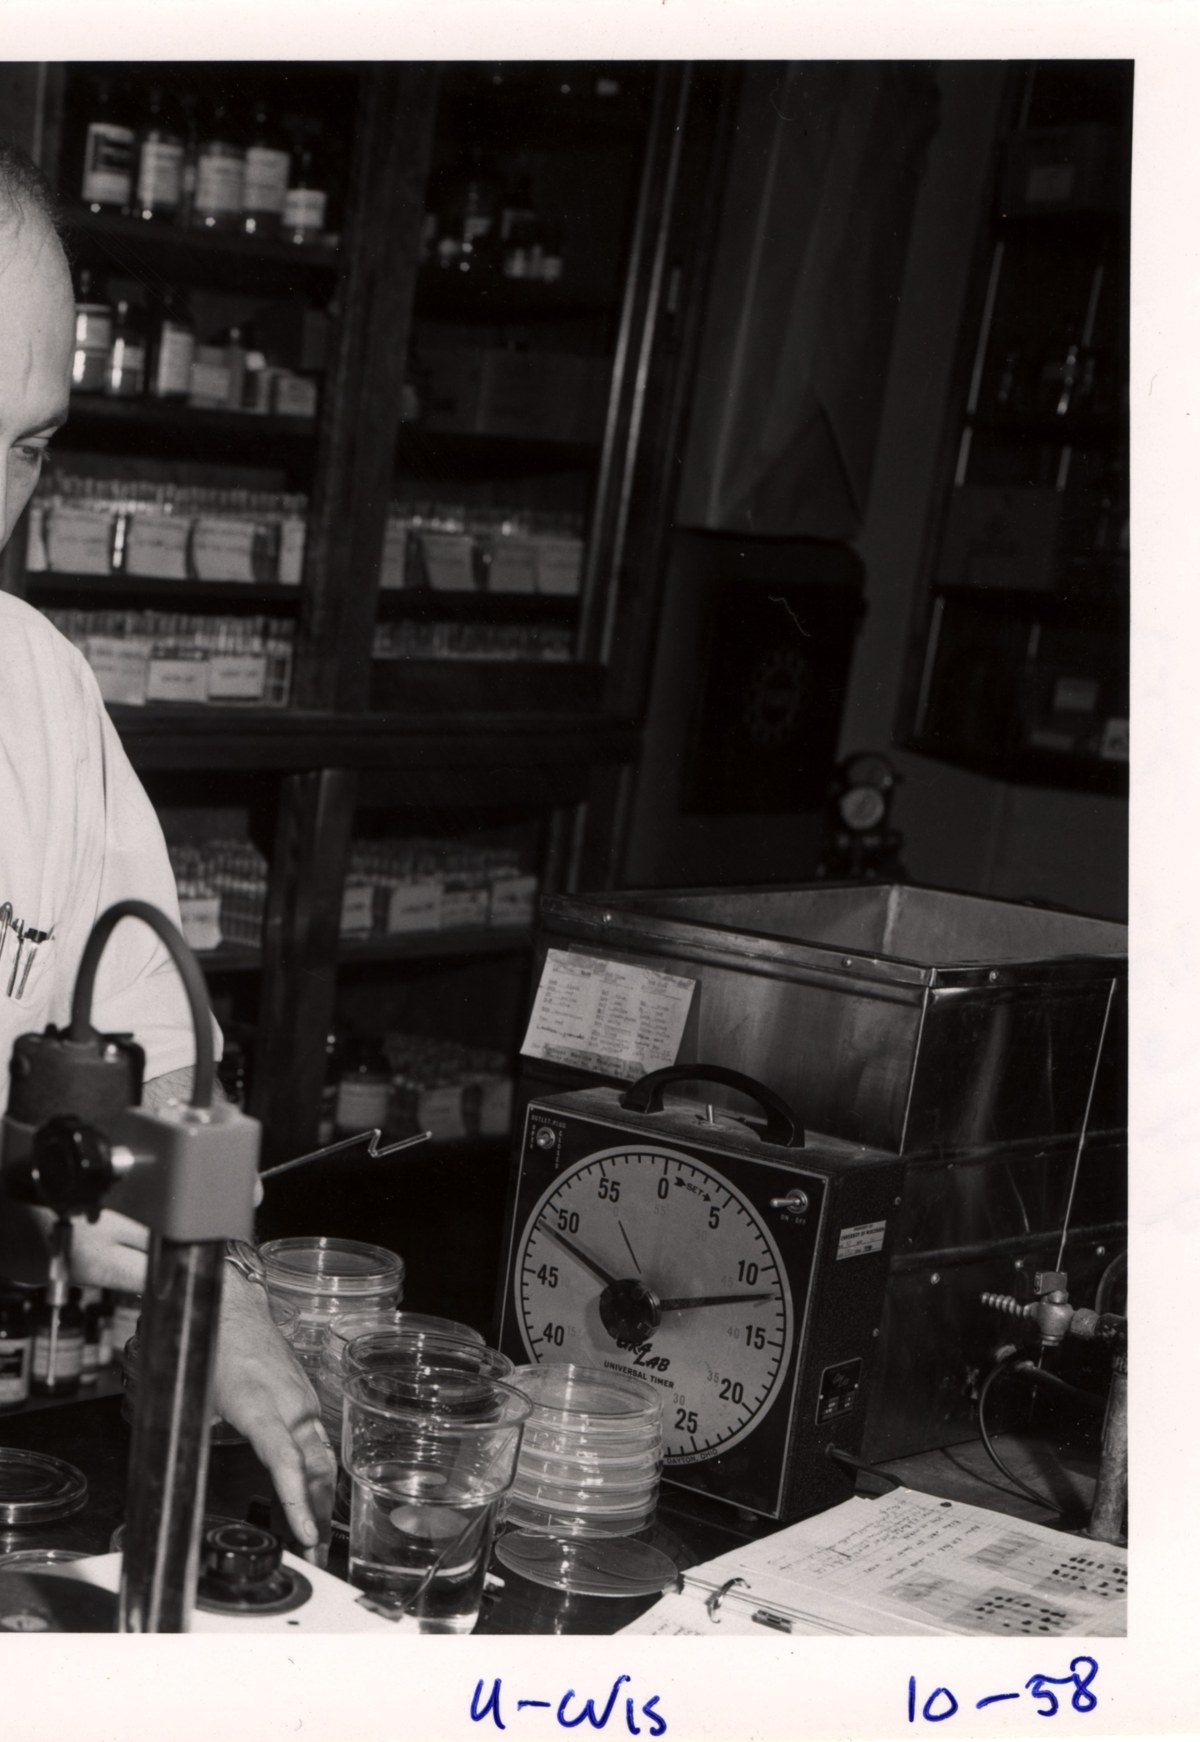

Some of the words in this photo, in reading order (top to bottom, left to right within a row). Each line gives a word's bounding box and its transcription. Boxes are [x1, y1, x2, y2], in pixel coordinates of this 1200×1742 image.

[598, 1177, 620, 1203] 55
[657, 1177, 669, 1200] 0
[685, 1182, 705, 1197] SET
[557, 1208, 580, 1234] 50
[708, 1206, 720, 1229] 5
[536, 1264, 559, 1288] 45
[737, 1259, 759, 1286] 10
[543, 1322, 565, 1346] 40
[726, 1326, 740, 1339] 40
[745, 1324, 766, 1350] 15
[633, 1350, 670, 1372] LAB
[604, 1360, 647, 1381] UNIVERSAL
[649, 1375, 675, 1389] TIMER
[707, 1370, 720, 1384] 35
[673, 1393, 686, 1406] 30
[719, 1378, 744, 1404] 20
[674, 1408, 698, 1434] 25
[700, 1448, 718, 1460] OHIO
